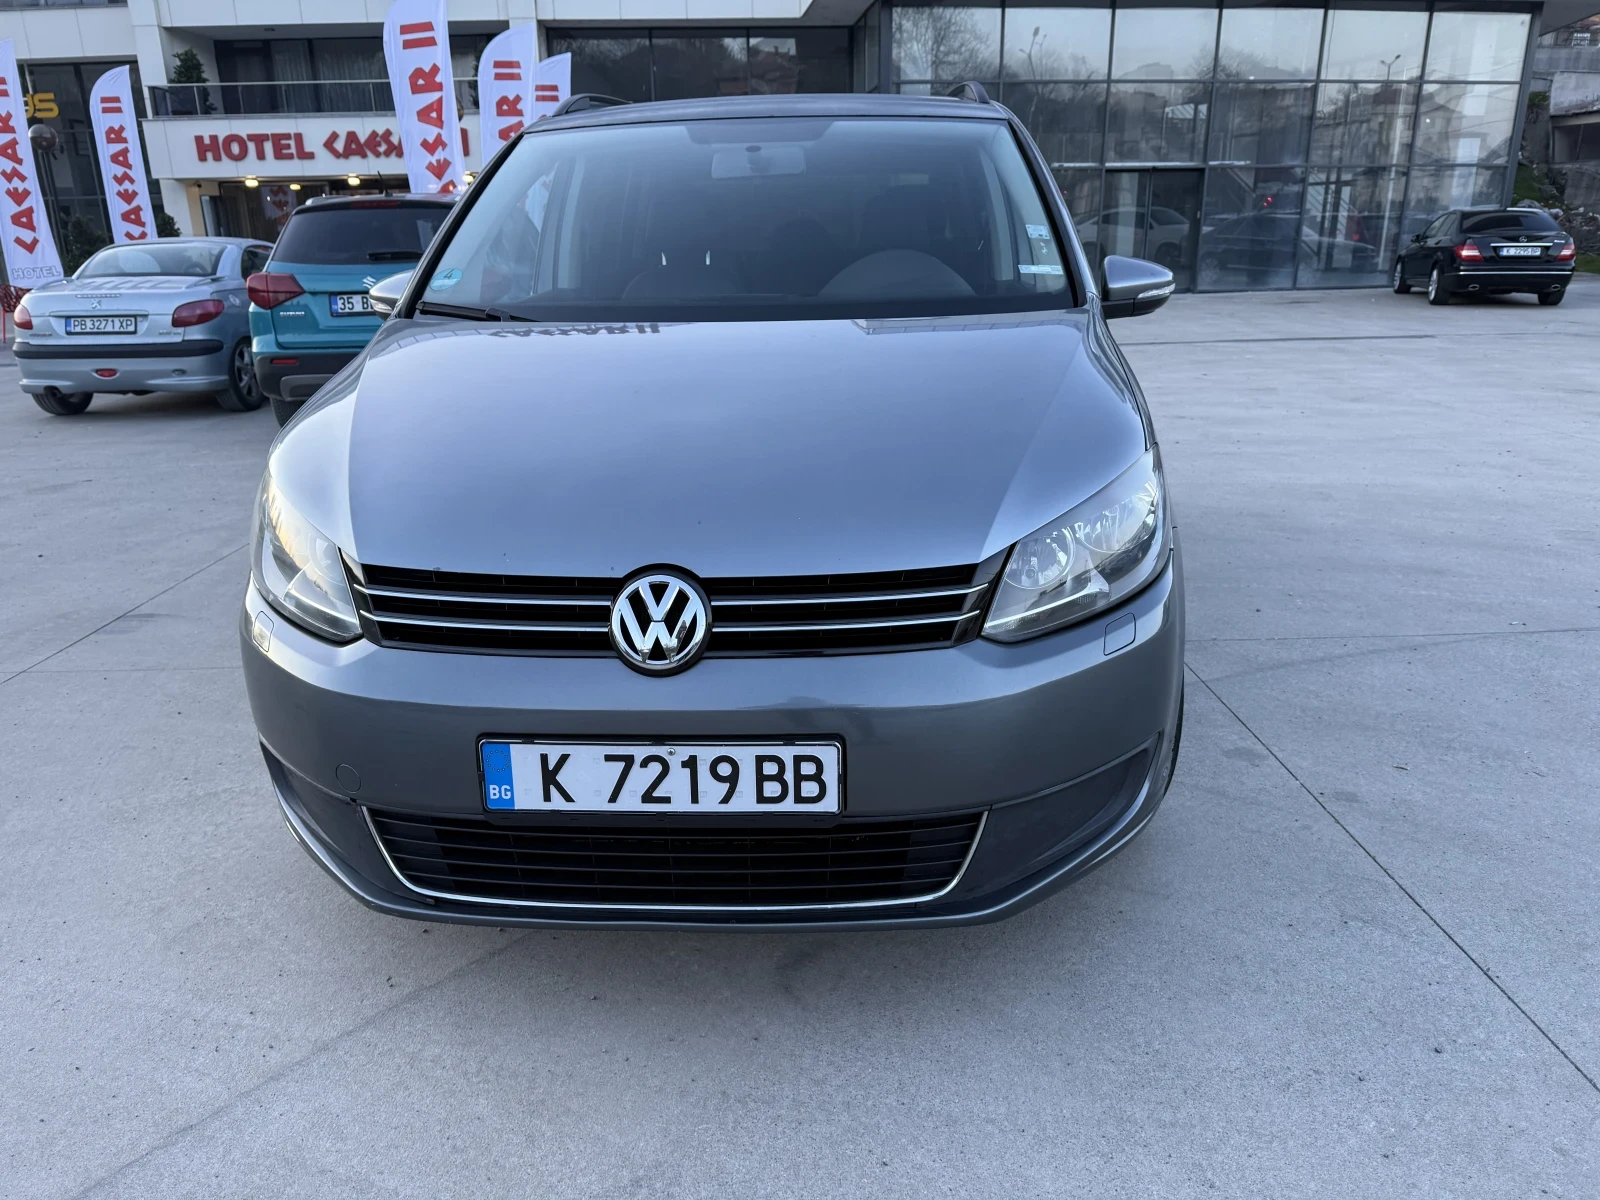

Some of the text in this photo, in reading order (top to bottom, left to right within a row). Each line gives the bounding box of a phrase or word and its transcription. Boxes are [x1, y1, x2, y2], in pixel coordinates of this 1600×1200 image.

[408, 63, 457, 193] ESAR
[194, 133, 315, 162] HOTEL
[322, 128, 404, 160] CAES
[11, 265, 62, 280] HOTEL
[338, 296, 354, 311] 35
[73, 319, 87, 331] PB
[89, 319, 116, 331] 3271
[118, 318, 133, 330] XP
[539, 752, 827, 805] K 7219 BB
[489, 784, 511, 799] BG
